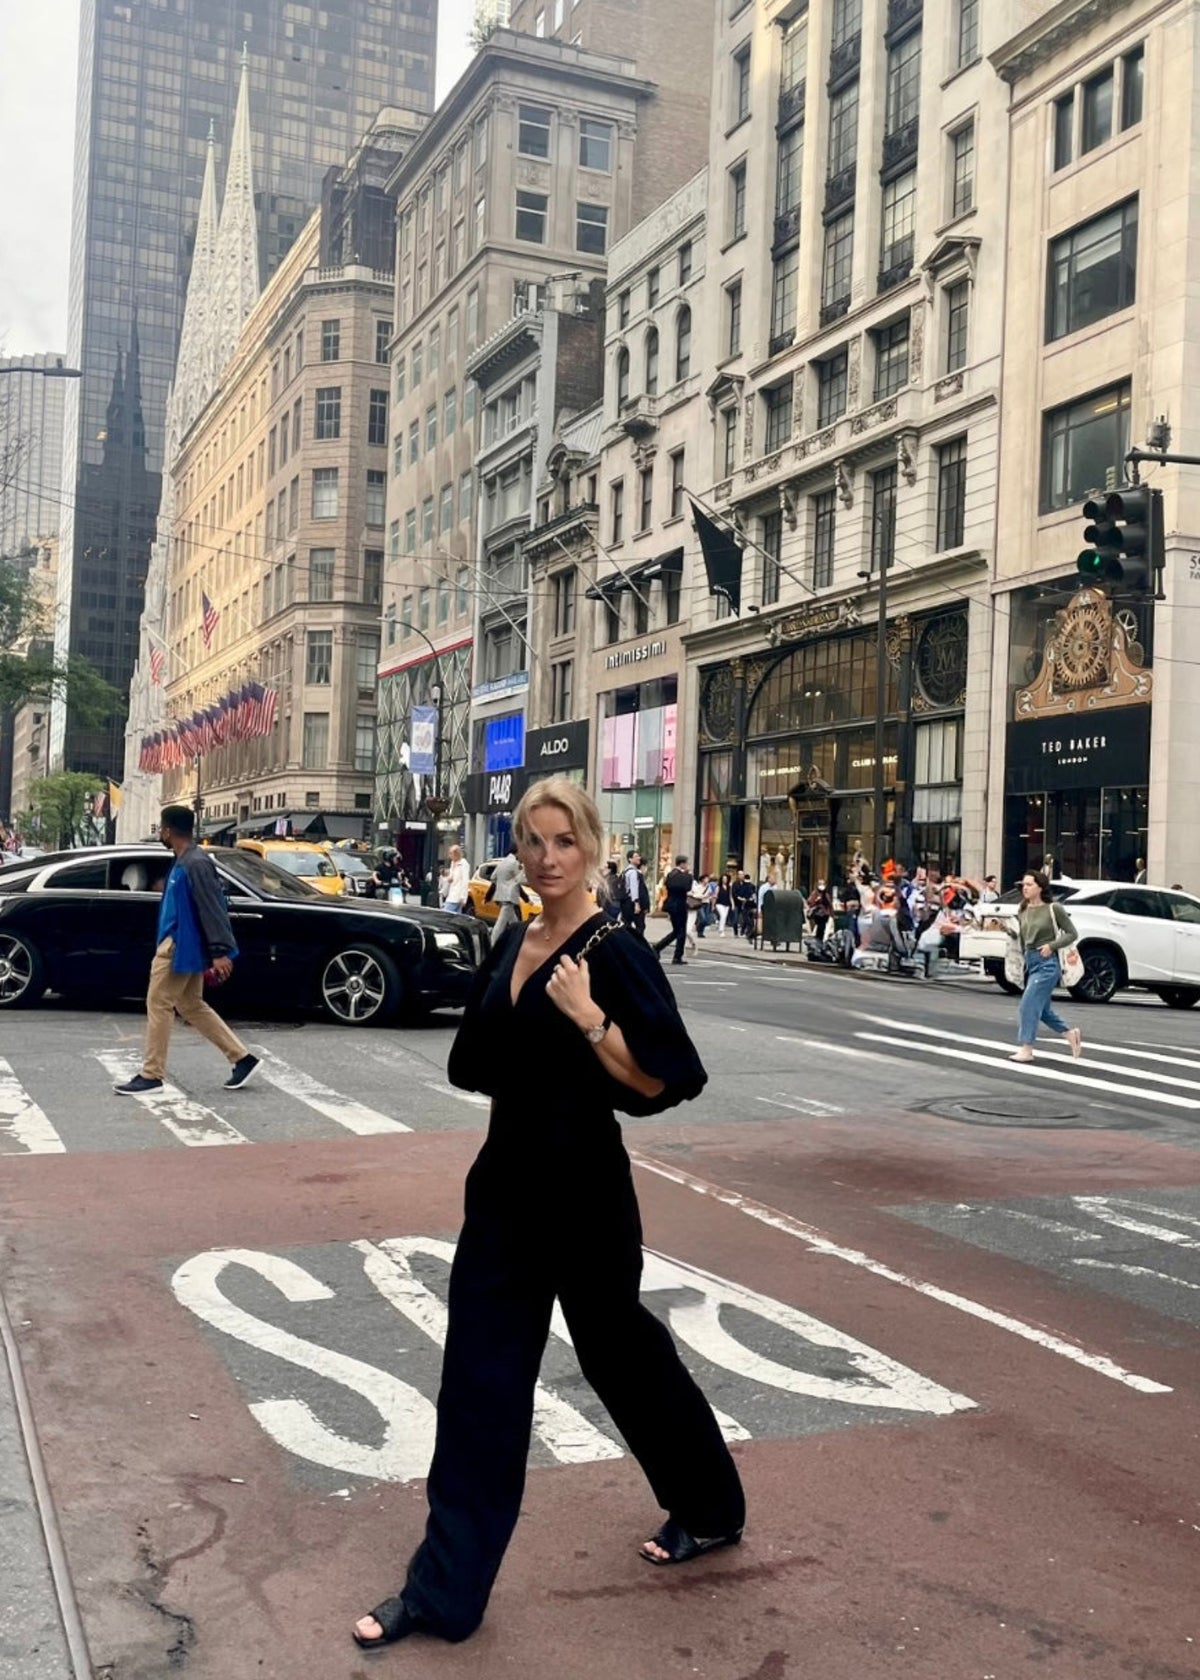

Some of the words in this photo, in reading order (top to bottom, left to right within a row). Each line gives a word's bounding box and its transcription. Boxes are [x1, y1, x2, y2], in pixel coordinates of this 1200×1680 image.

[540, 738, 569, 756] ALDO
[1041, 740, 1062, 754] TED
[1069, 736, 1107, 750] BAKER
[488, 773, 512, 806] P448
